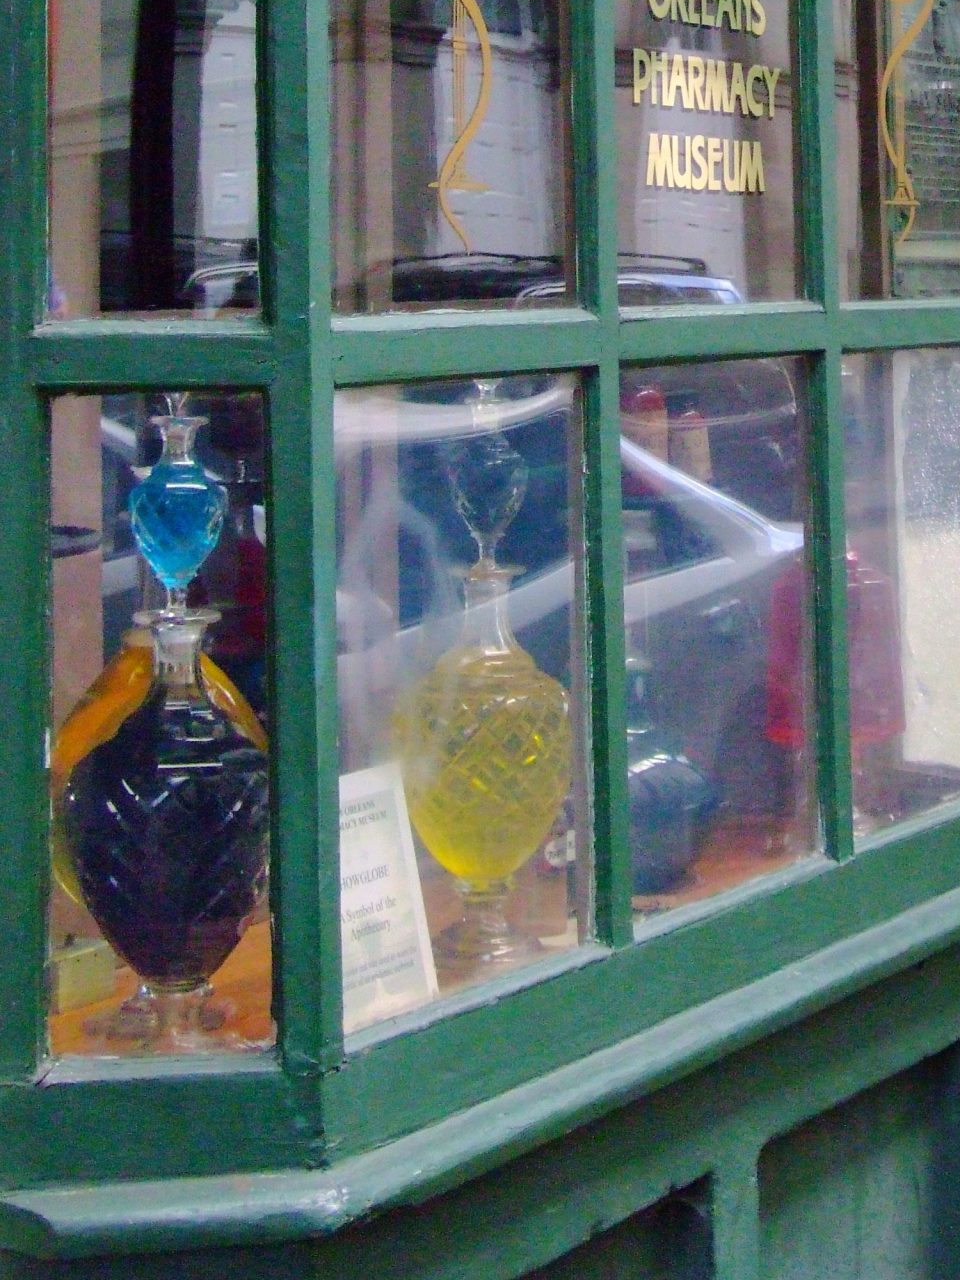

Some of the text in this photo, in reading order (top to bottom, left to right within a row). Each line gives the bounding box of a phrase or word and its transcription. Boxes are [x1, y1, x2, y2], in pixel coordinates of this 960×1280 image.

[631, 47, 781, 120] PHARMACY
[645, 132, 766, 194] MUSEUM
[346, 902, 374, 923] Symbol
[376, 898, 384, 912] of
